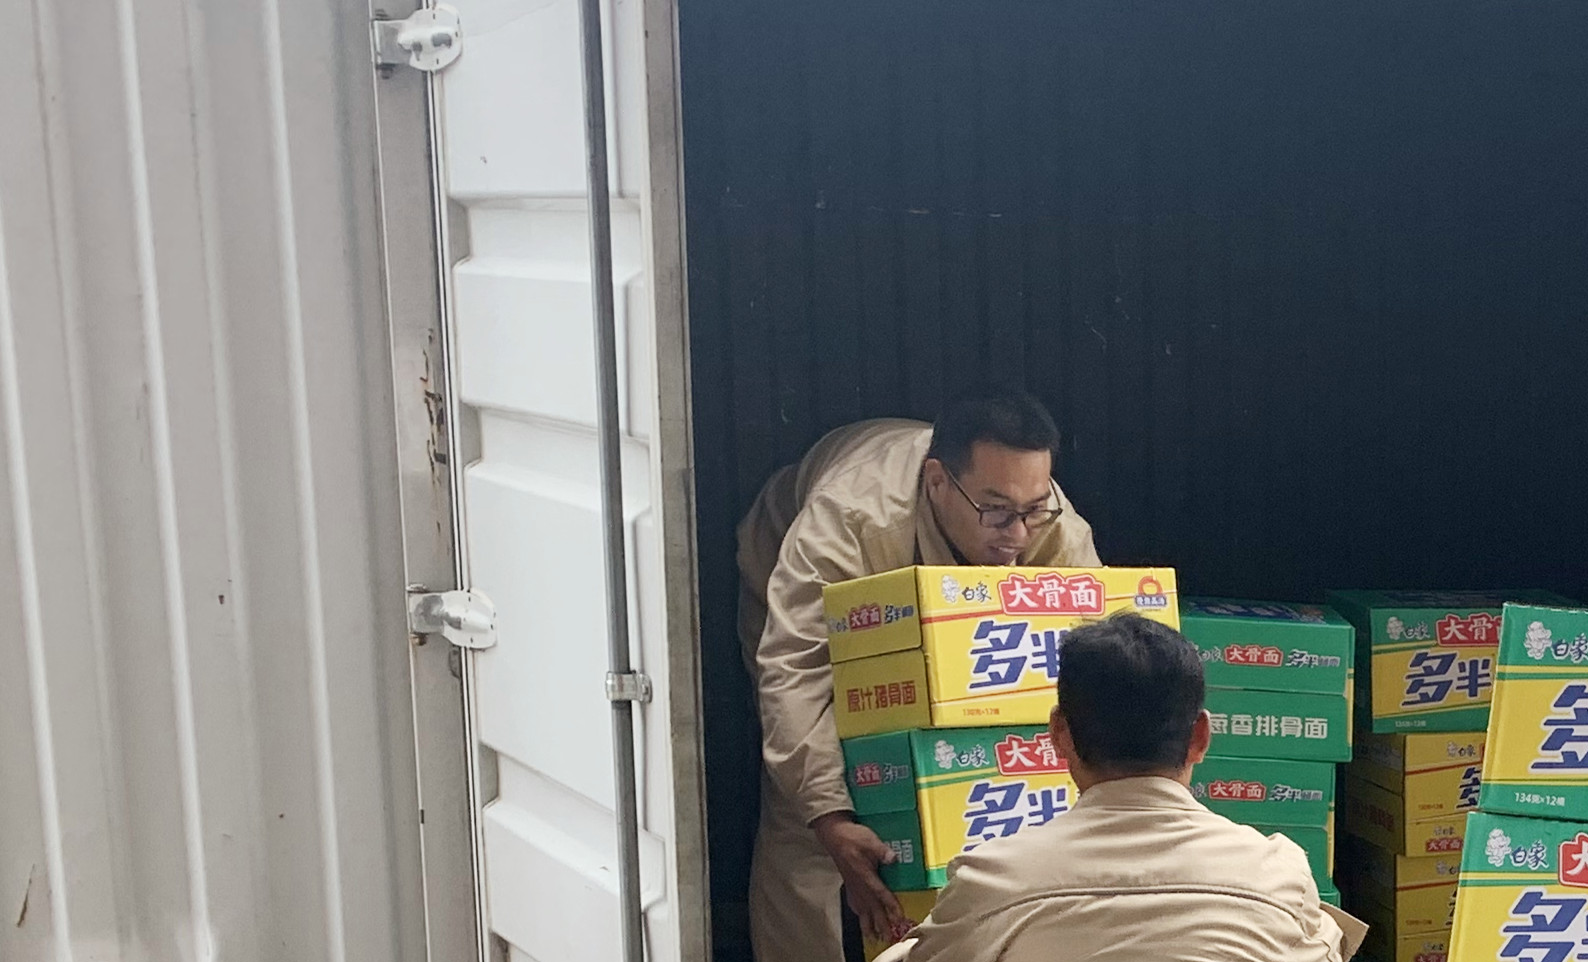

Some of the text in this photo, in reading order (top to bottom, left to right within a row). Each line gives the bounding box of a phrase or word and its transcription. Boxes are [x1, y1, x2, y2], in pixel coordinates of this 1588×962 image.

[1006, 573, 1098, 610] 大骨面
[1441, 614, 1501, 641] 大骨
[1229, 647, 1280, 664] 大骨面
[1400, 651, 1493, 707] 多半
[1212, 782, 1263, 798] 大骨面
[1510, 840, 1550, 870] 白象
